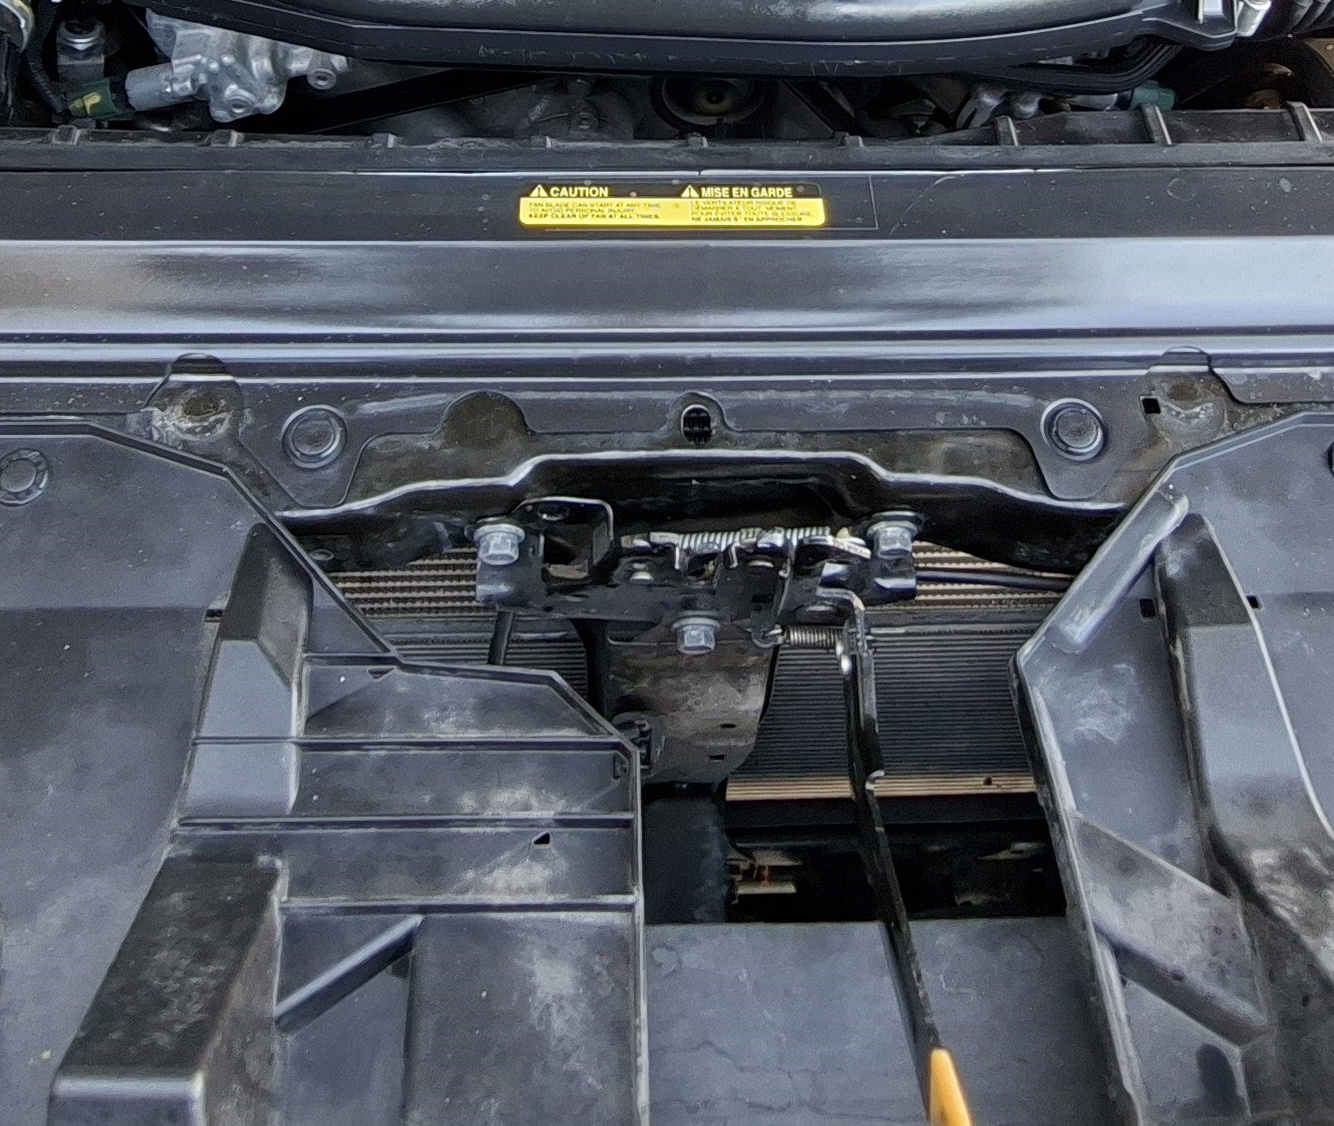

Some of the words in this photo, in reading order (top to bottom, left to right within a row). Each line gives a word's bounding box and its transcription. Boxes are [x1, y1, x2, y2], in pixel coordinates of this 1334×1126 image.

[550, 186, 609, 197] CAUTION
[701, 186, 729, 198] MISE
[732, 186, 749, 198] EN
[751, 186, 793, 198] GARDE
